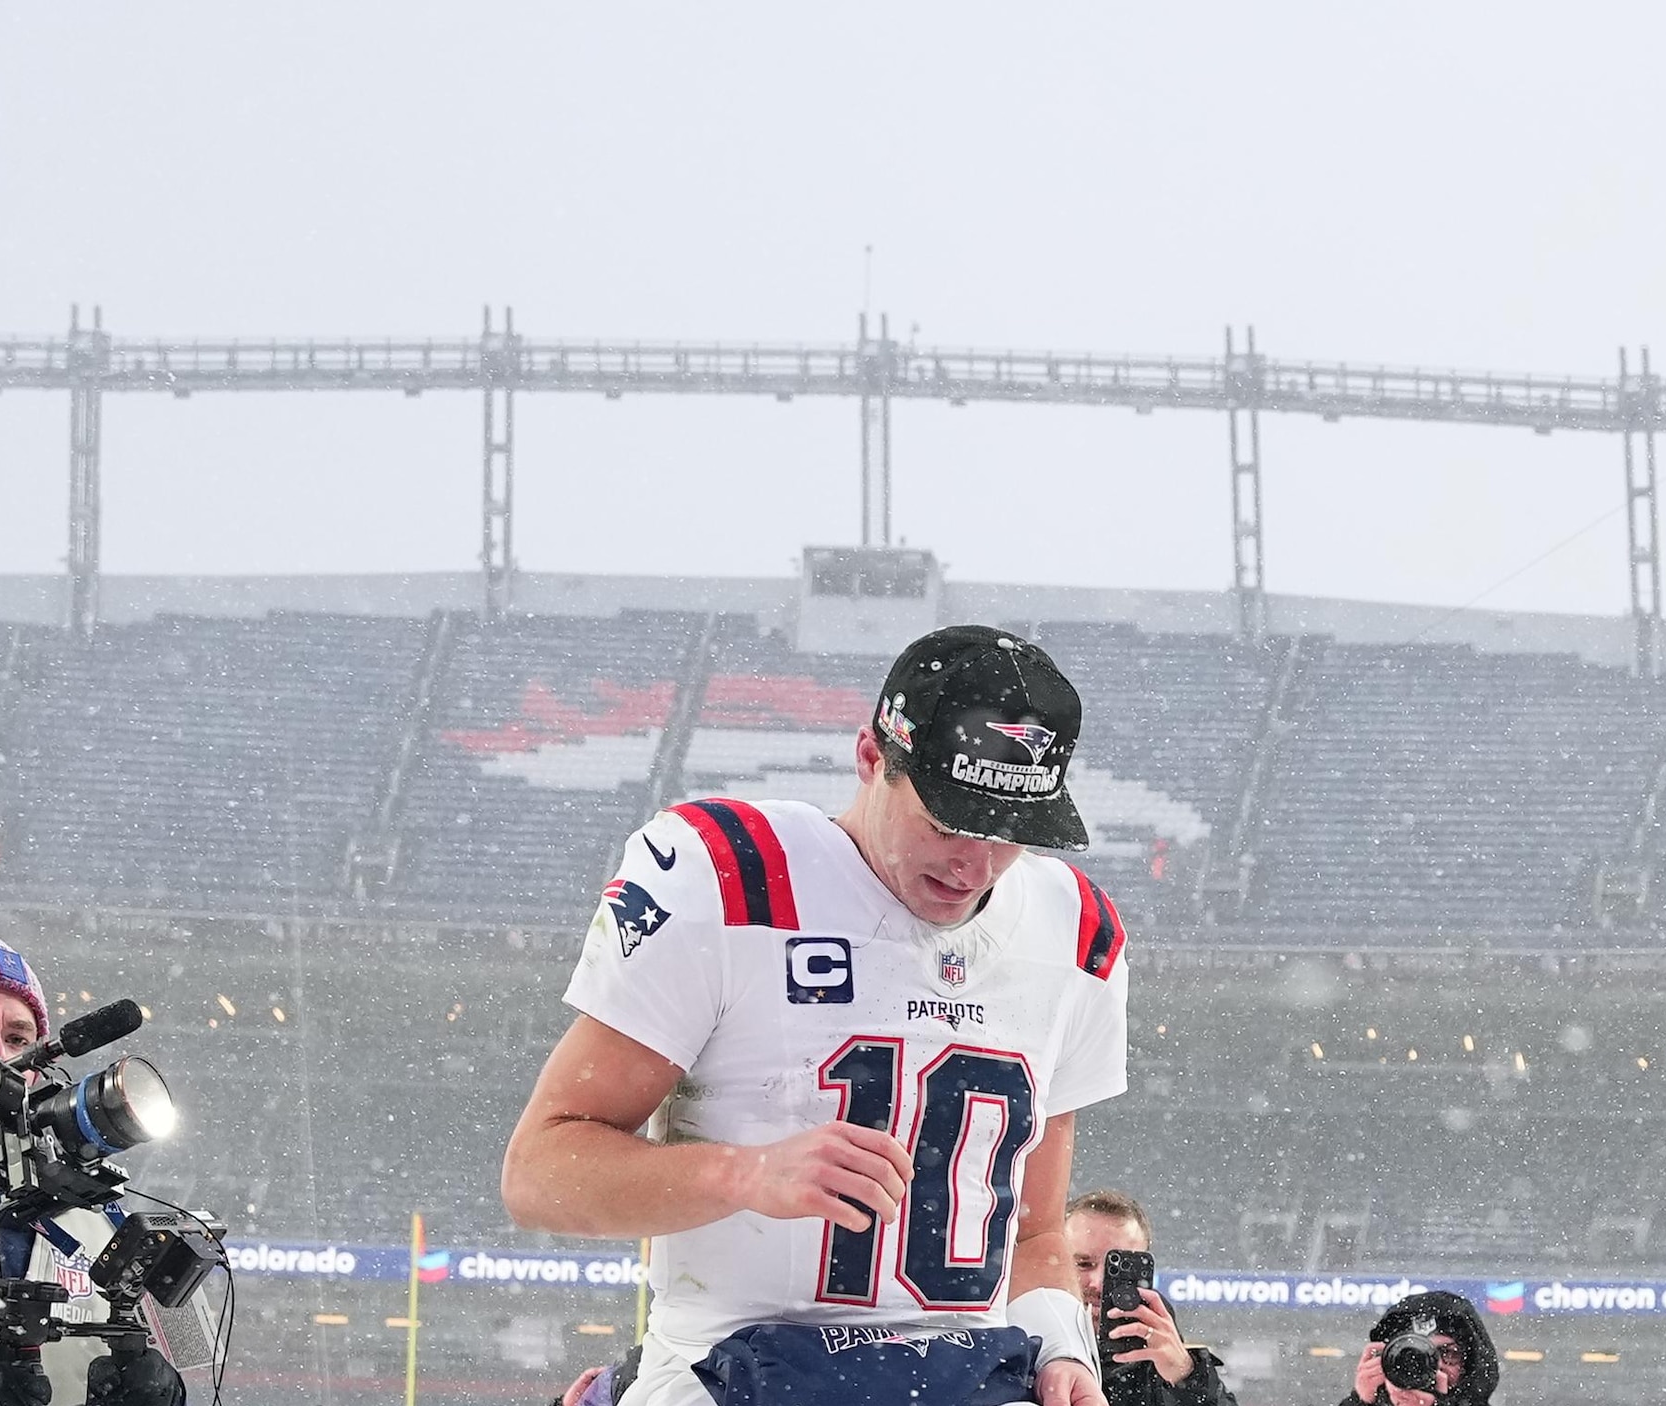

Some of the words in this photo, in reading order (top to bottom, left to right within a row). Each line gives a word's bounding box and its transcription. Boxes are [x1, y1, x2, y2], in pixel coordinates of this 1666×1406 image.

[952, 753, 1060, 792] CHAMPIONS
[791, 942, 848, 987] C
[944, 965, 965, 982] NFL
[907, 1000, 984, 1024] PATRIOTS
[814, 1034, 1037, 1311] 10
[227, 1244, 356, 1275] colorado
[458, 1252, 579, 1282] chevron
[56, 1266, 89, 1294] NFL
[1168, 1274, 1290, 1302] chevron
[1534, 1281, 1656, 1310] chevron
[50, 1302, 93, 1324] MEDIA
